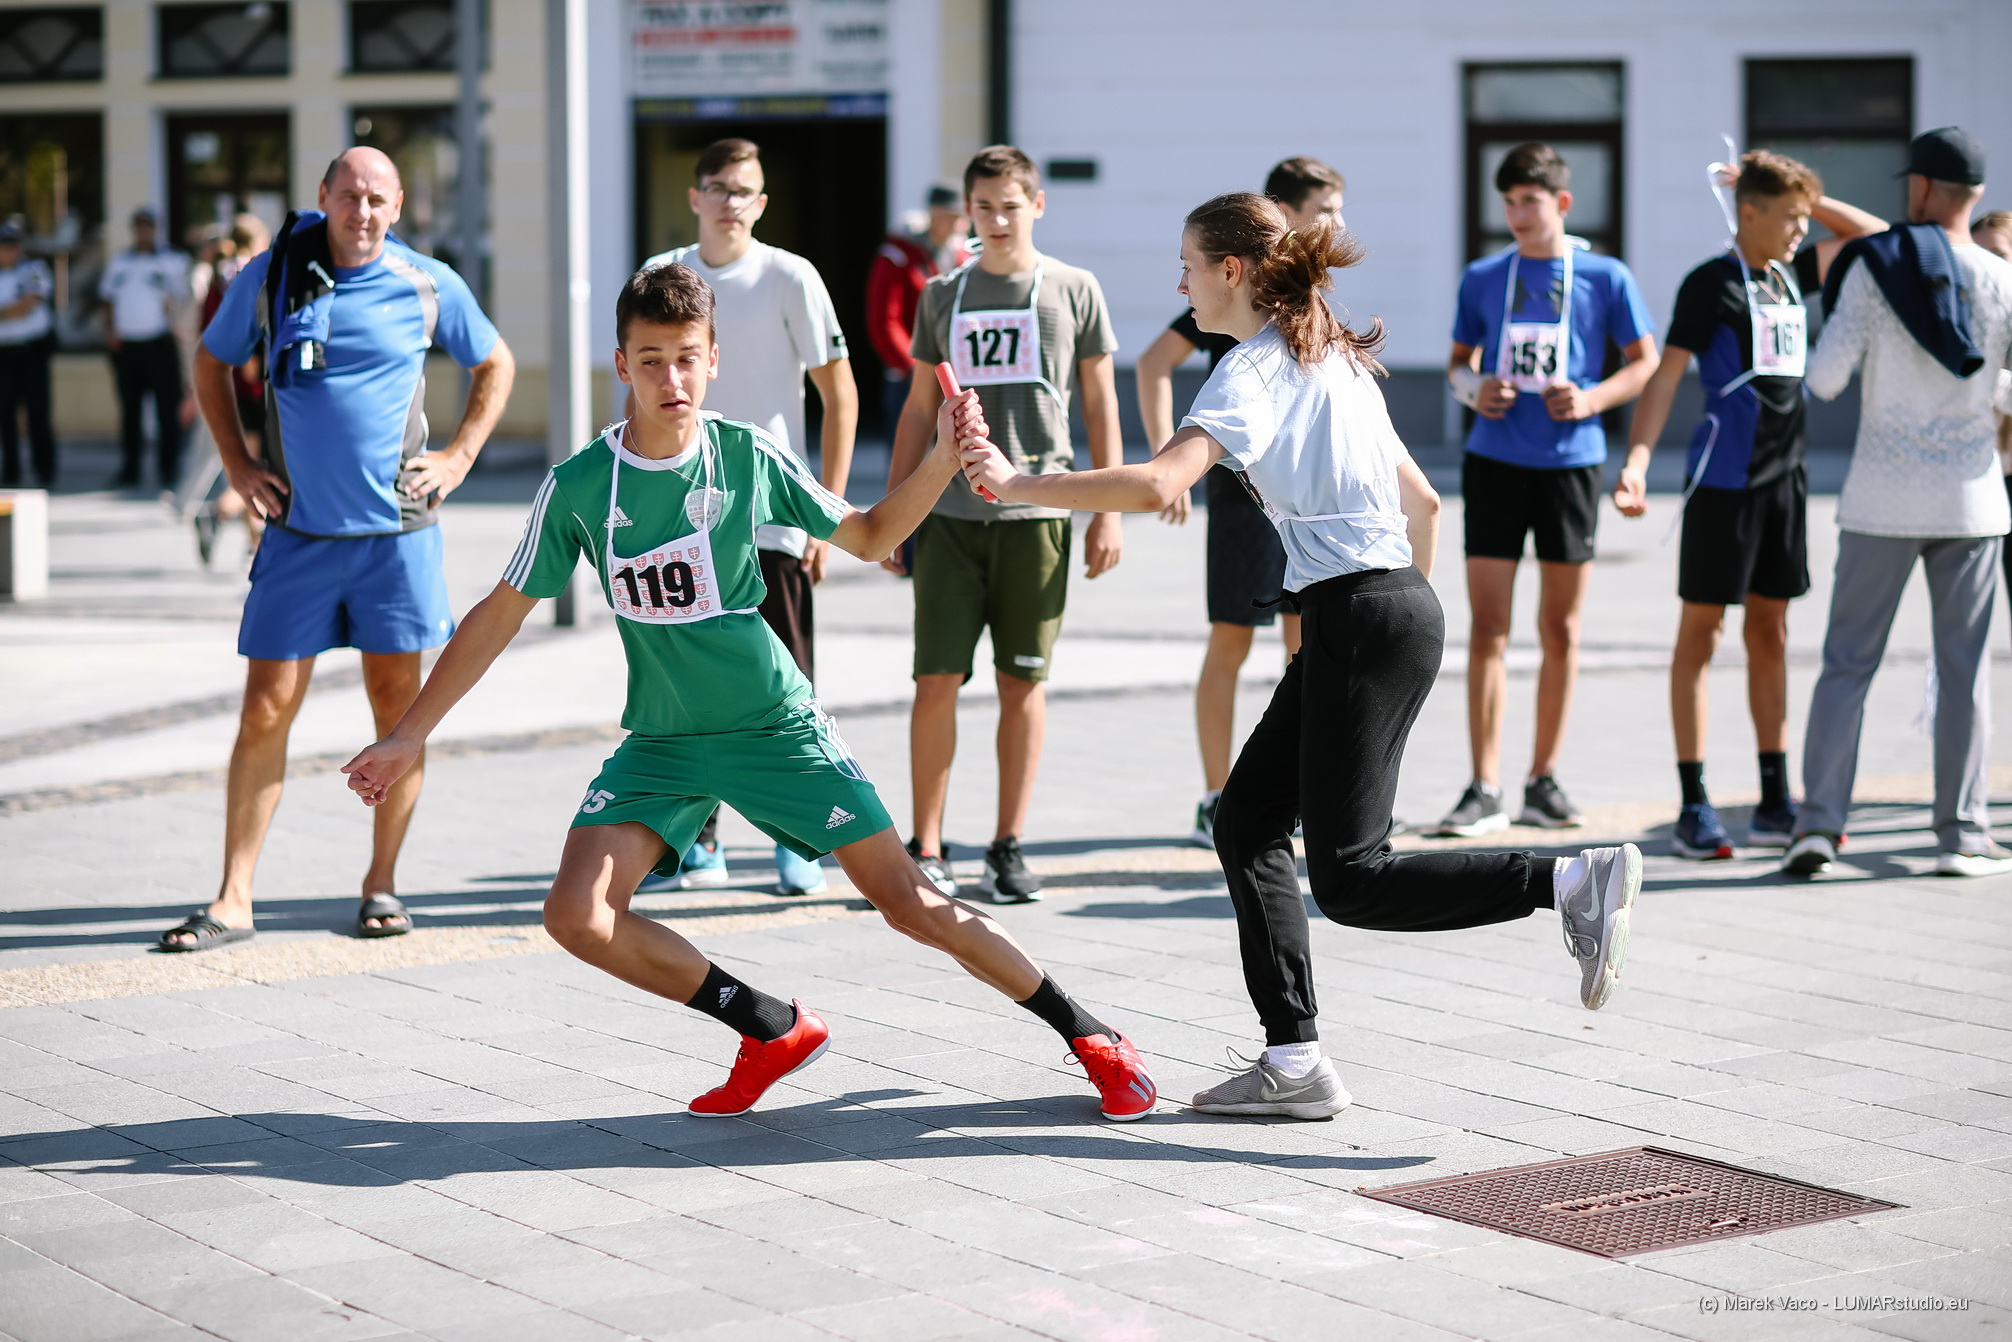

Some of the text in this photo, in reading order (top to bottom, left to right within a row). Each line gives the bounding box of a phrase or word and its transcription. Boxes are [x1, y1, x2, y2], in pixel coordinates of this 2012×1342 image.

[965, 328, 1020, 367] 127
[1511, 341, 1557, 376] 153
[615, 561, 696, 608] 119
[825, 813, 856, 830] adidas
[720, 984, 739, 1009] adidas
